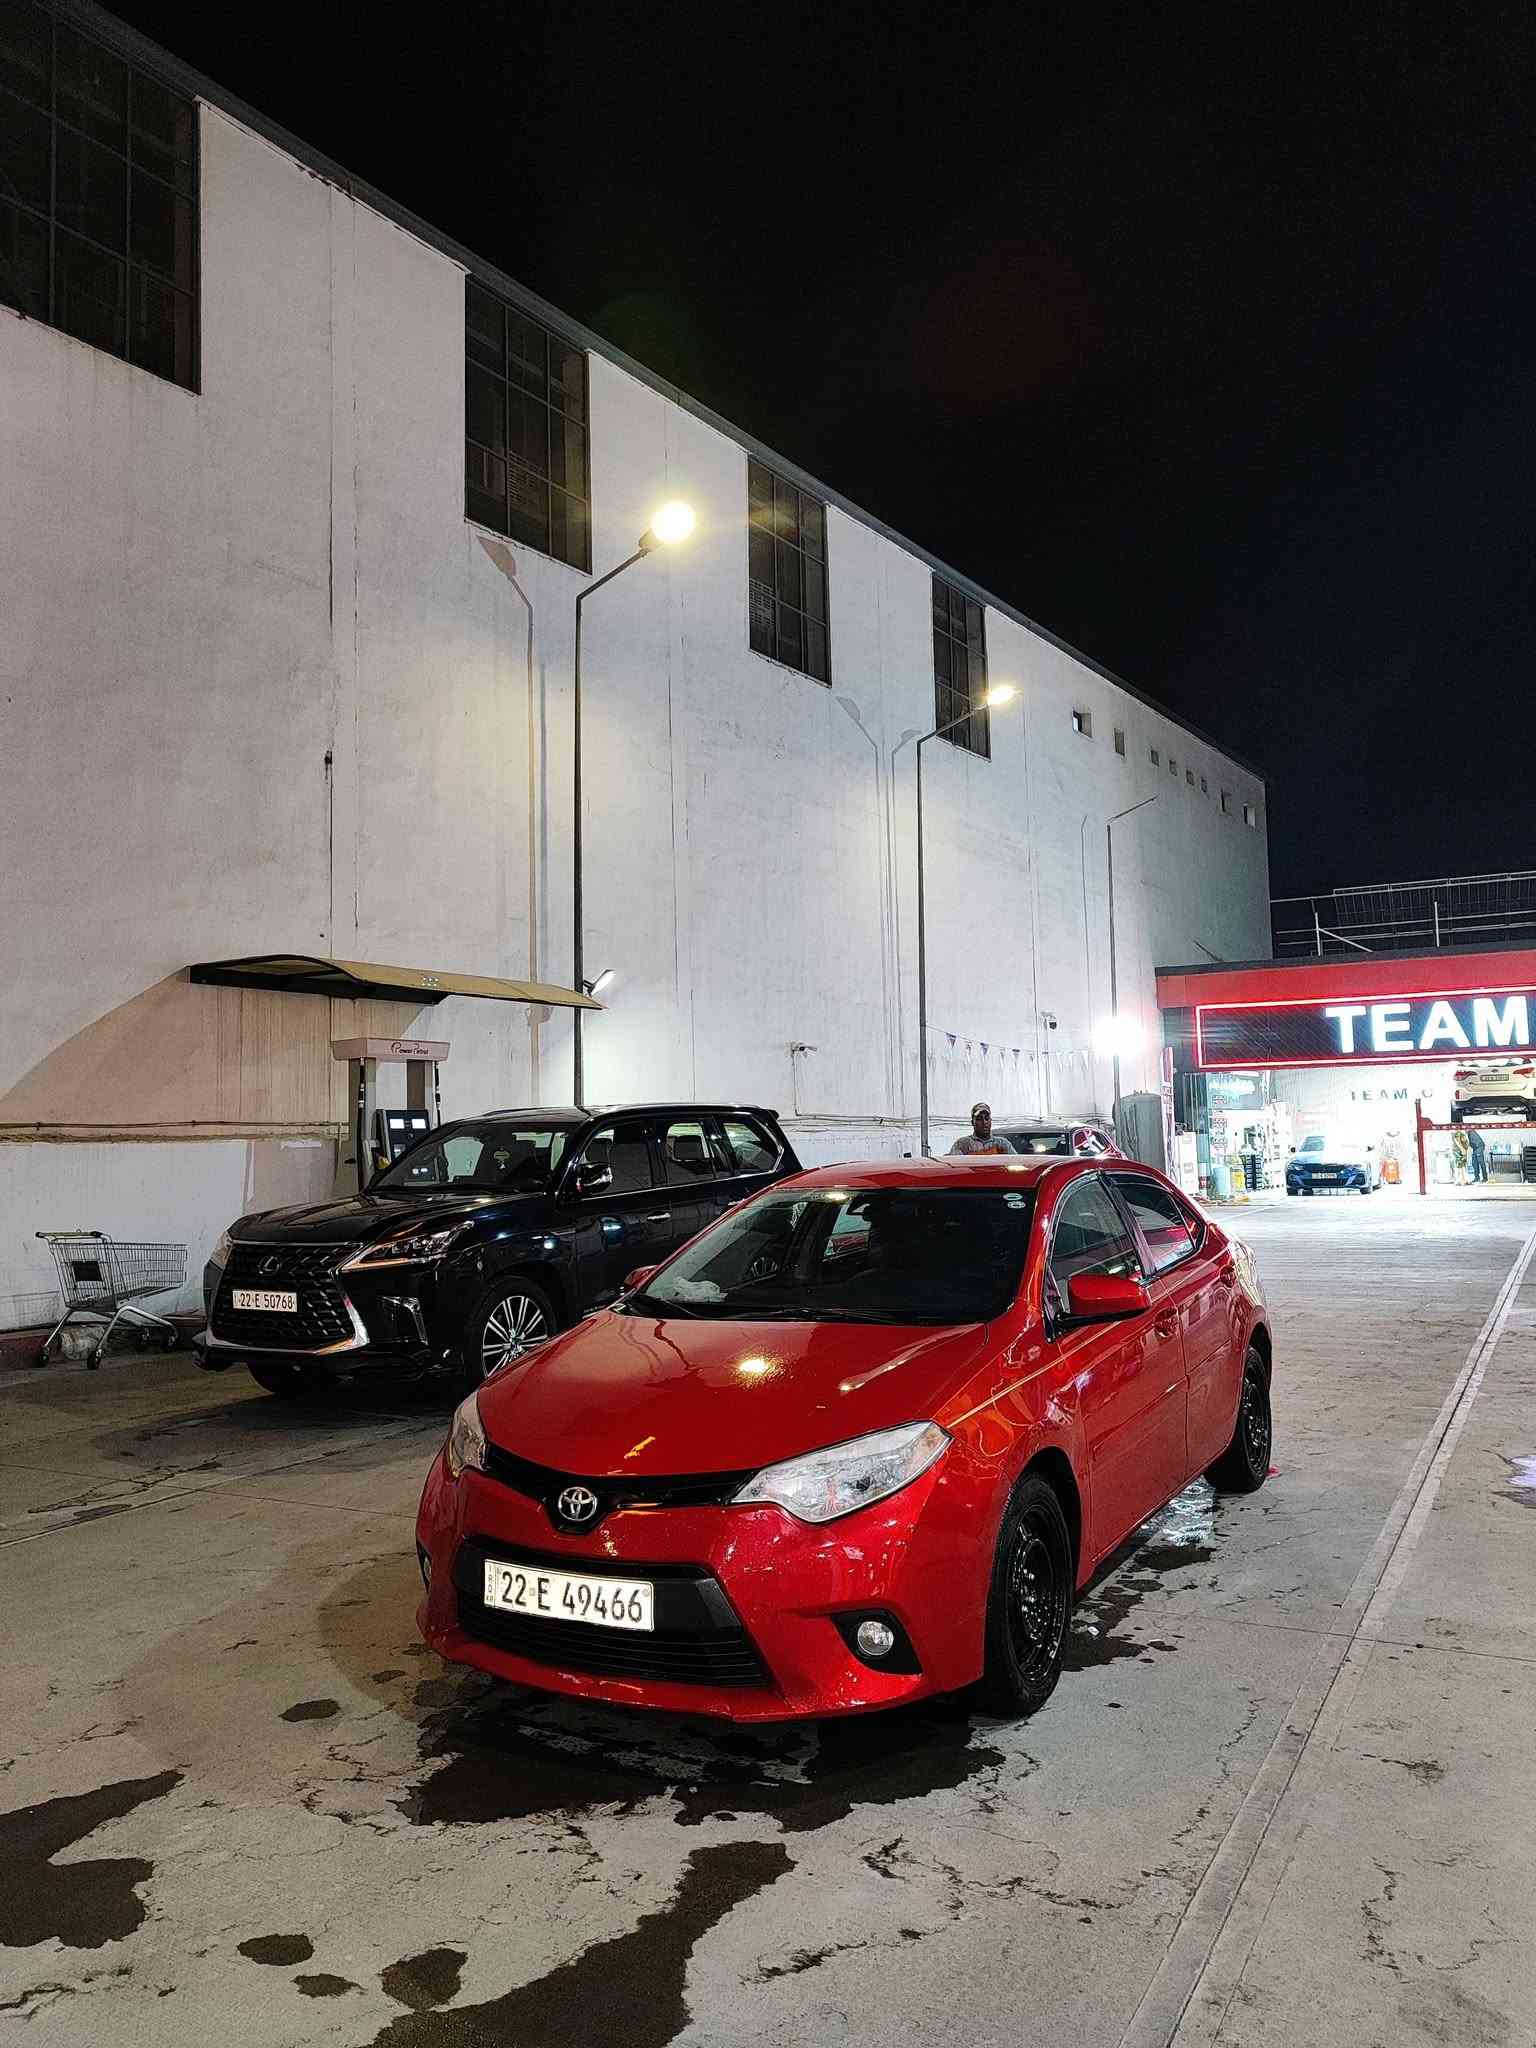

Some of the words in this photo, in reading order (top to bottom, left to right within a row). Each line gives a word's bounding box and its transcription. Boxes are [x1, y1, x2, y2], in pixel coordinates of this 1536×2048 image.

[1325, 996, 1529, 1054] TEAM
[240, 1293, 251, 1307] 22
[255, 1293, 261, 1308] E
[263, 1294, 293, 1309] 50768
[501, 1571, 527, 1607] 22
[537, 1576, 551, 1611] E
[562, 1581, 642, 1623] 49466
